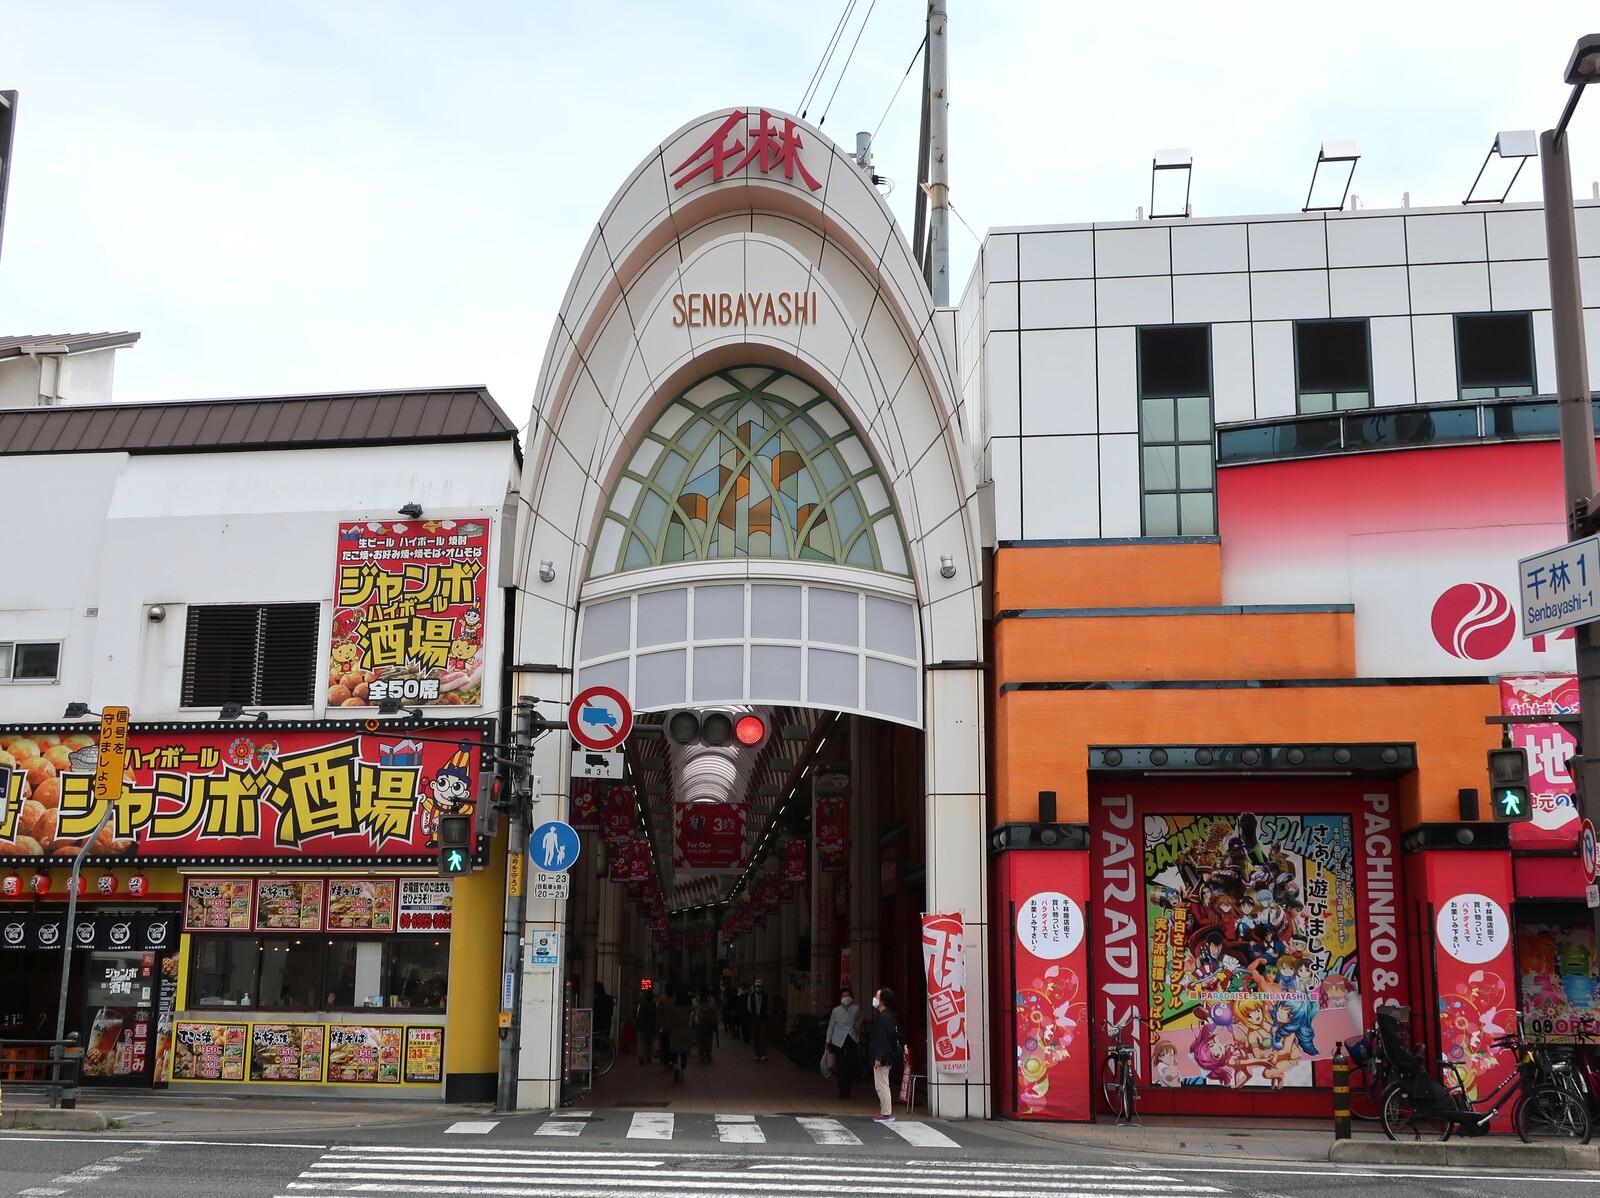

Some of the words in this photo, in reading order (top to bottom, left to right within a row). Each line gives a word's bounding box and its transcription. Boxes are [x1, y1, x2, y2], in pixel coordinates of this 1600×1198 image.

[670, 108, 822, 191] 千林
[672, 291, 817, 327] SENBAYASHI
[358, 537, 394, 548] 生ビール
[400, 536, 444, 547] ハイボール
[341, 563, 481, 606] ジャンボ
[367, 597, 448, 621] ハイボール
[1528, 590, 1593, 624] Senbayashi-1
[356, 616, 455, 673] 酒場
[368, 679, 439, 700] 全50席
[113, 710, 128, 755] 信号を
[96, 712, 115, 797] 守りましょう
[124, 746, 220, 770] ハイボール
[1363, 793, 1398, 963] PACHINKO
[1168, 907, 1188, 1011] 面白さにコダワル
[105, 967, 138, 978] ジャンボ
[1371, 967, 1399, 992] &
[109, 982, 132, 994] 酒場
[1201, 992, 1249, 1000] PARADAISE
[1253, 992, 1306, 1000] SENBAYASHI
[201, 1046, 217, 1054] 350
[355, 1049, 372, 1057] 450
